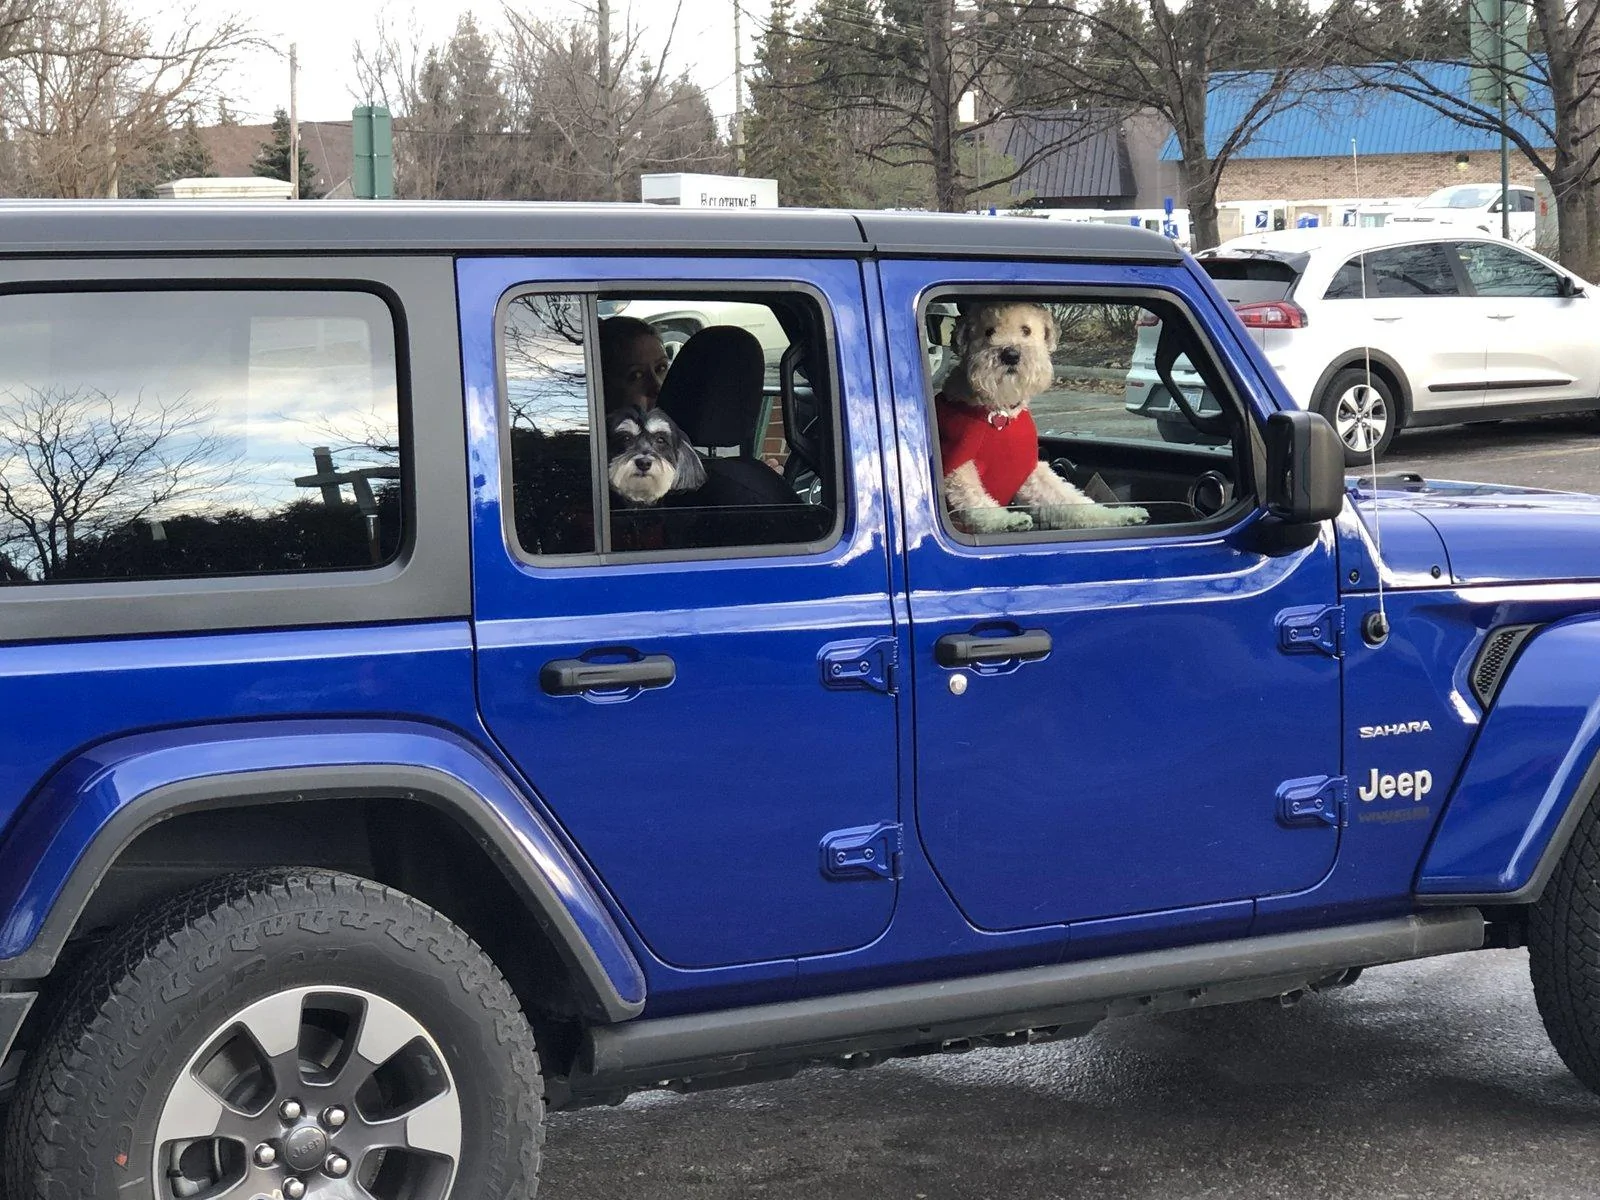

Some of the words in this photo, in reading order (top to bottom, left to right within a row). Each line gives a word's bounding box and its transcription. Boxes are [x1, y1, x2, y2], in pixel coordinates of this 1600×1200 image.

[708, 197, 749, 207] CLOTHING
[1359, 720, 1432, 738] SAHARA
[1359, 768, 1433, 801] Jeep
[292, 1138, 322, 1159] Jeep
